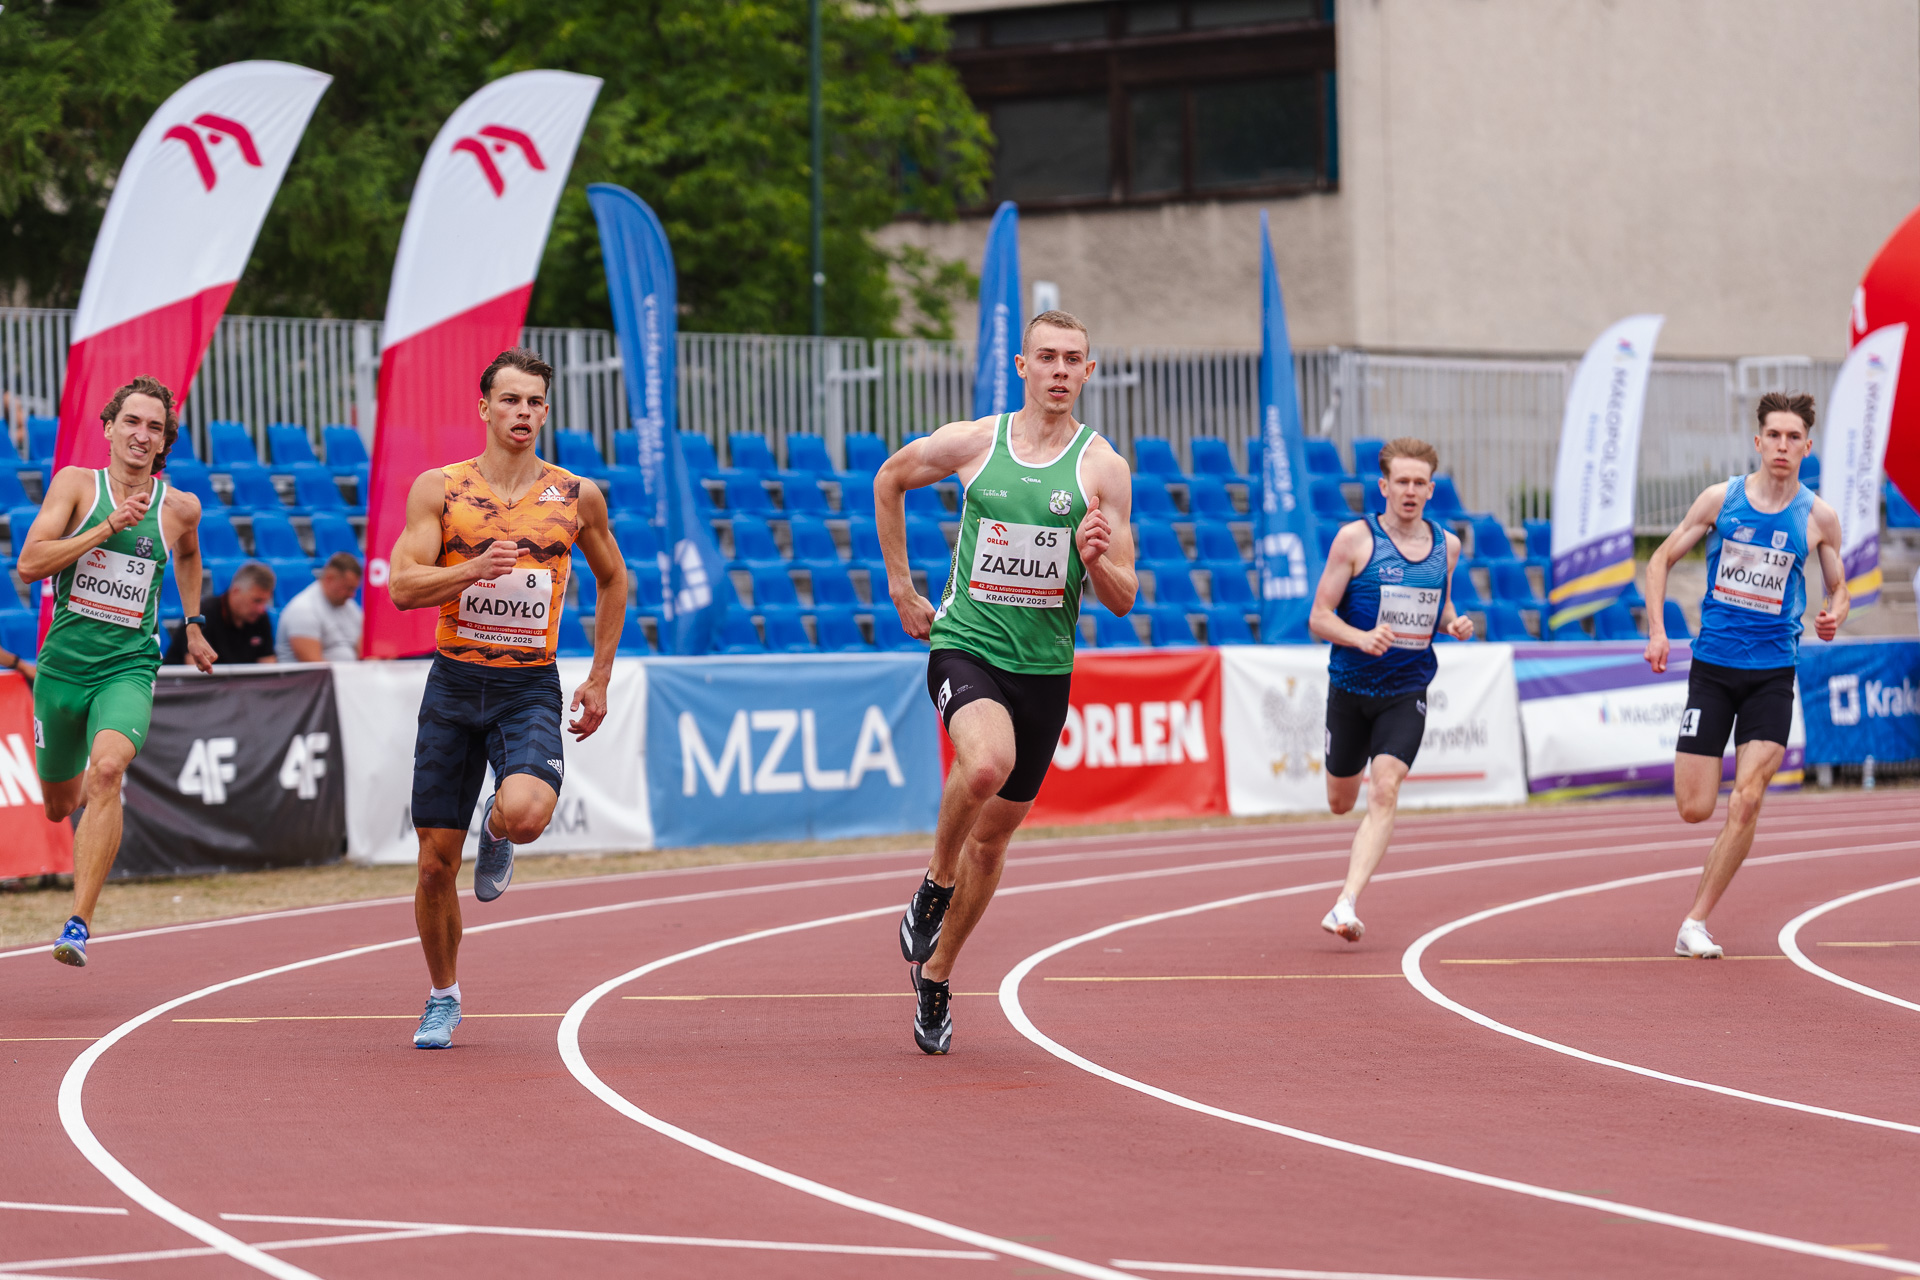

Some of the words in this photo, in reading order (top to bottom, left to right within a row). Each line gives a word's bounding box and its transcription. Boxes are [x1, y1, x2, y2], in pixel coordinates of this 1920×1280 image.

[986, 537, 1009, 546] ORLEN
[1034, 531, 1058, 548] 65
[86, 560, 107, 570] ORLEN
[126, 560, 146, 576] 53
[980, 553, 1059, 579] ZAZULA
[1763, 551, 1789, 567] 113
[473, 581, 496, 589] ORLEN
[526, 573, 537, 589] 8
[1720, 564, 1784, 591] WÓJCIAK
[75, 573, 147, 604] GROŃSKI
[999, 586, 1031, 594] Mistrzostwa
[466, 595, 545, 619] KADYŁO
[985, 593, 1025, 604] KRAKÓW
[1026, 597, 1047, 605] 2025
[80, 606, 112, 620] KRAKÓW
[112, 615, 130, 624] 2025
[474, 632, 512, 643] KRAKÓW
[512, 636, 533, 644] 2025
[487, 625, 517, 634] Mistrzostwa
[940, 687, 947, 712] 6
[1619, 703, 1684, 726] MAŁOPO
[1682, 711, 1693, 733] 4
[1051, 700, 1209, 771] ORLEN
[678, 705, 905, 797] MZLA
[177, 737, 237, 805] 4F
[279, 732, 330, 799] 4F
